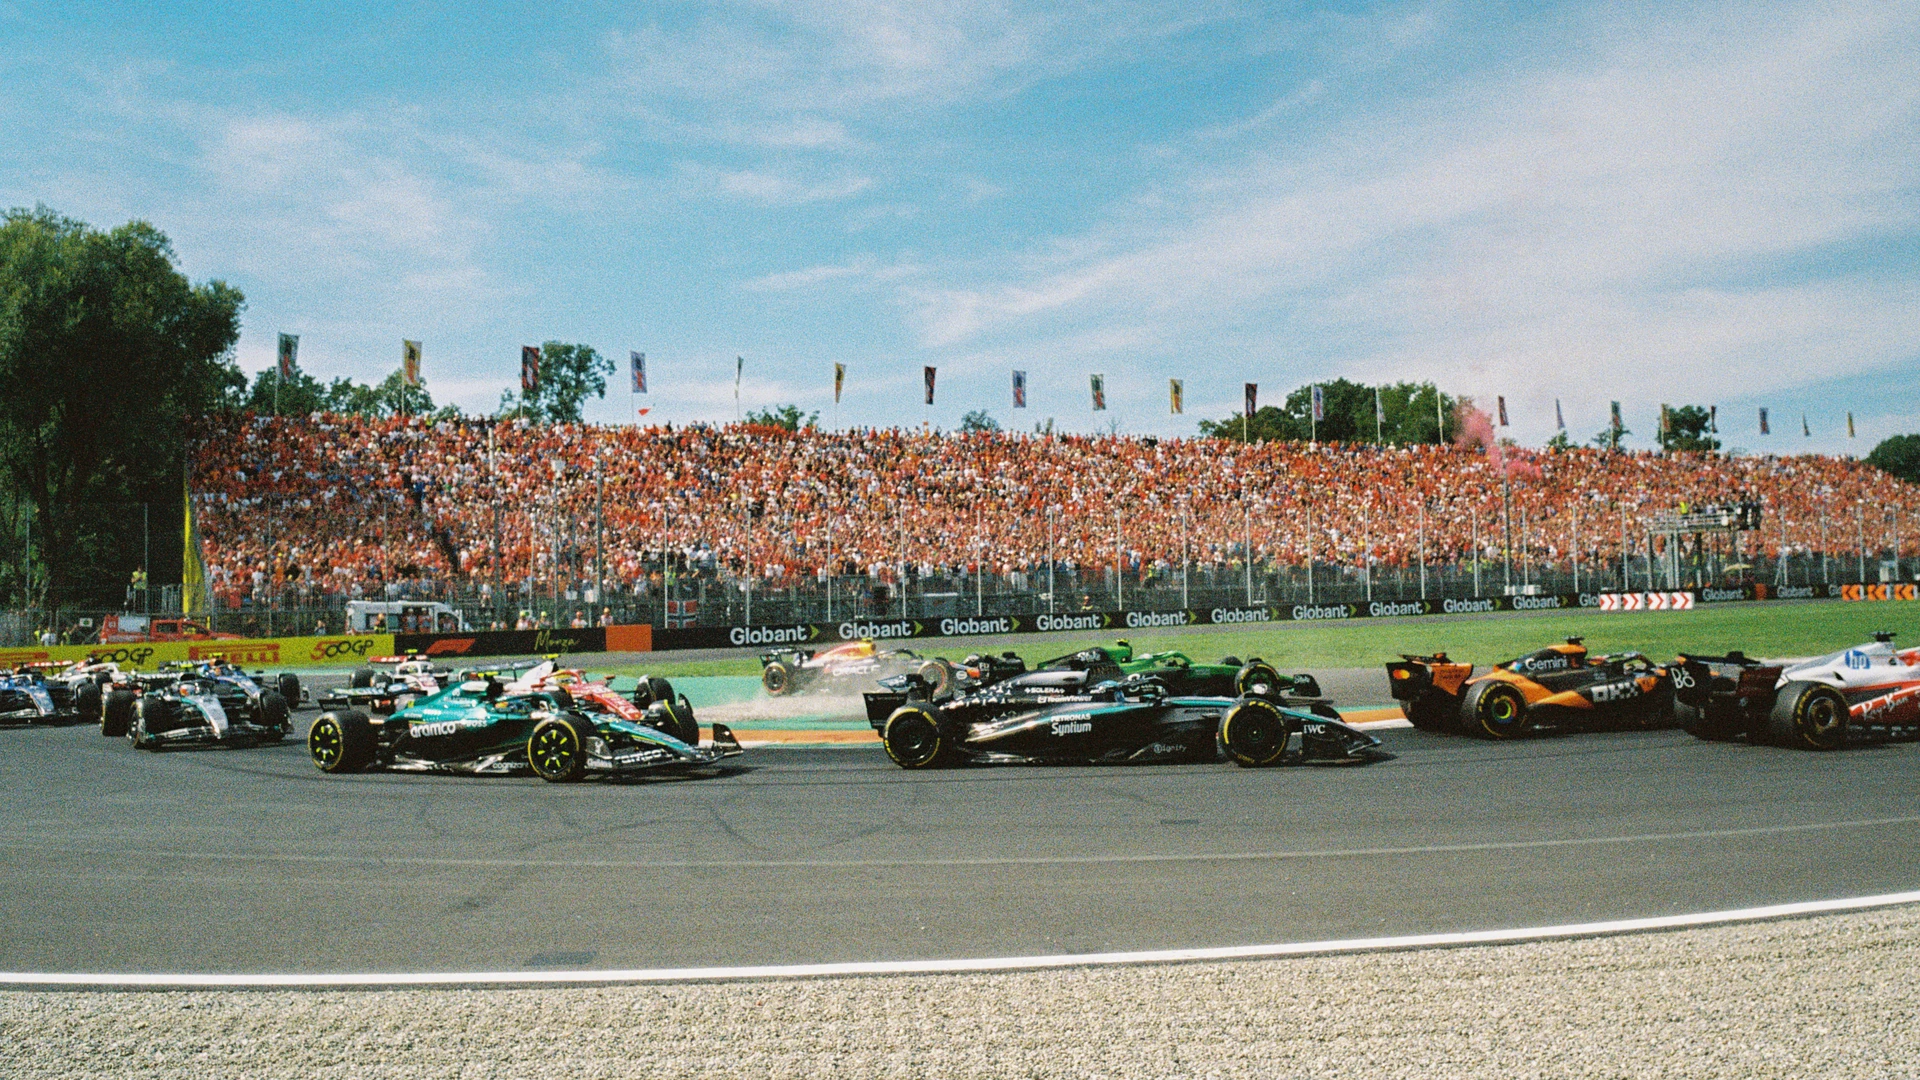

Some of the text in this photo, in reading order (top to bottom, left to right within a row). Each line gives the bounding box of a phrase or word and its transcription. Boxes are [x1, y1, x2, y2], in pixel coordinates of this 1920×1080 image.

[1369, 601, 1424, 617] Globant
[1443, 598, 1494, 613] Globant
[1513, 595, 1560, 610] Globant
[1126, 609, 1187, 628] Globant
[1211, 606, 1270, 624] Globant
[1292, 604, 1348, 620] Globant
[838, 620, 912, 640] Globant
[940, 616, 1009, 635] Globant
[1036, 613, 1101, 632] Globant
[729, 625, 807, 645] Globant
[188, 643, 280, 663] PIELLI
[1525, 655, 1567, 672] Gemini
[410, 721, 457, 739] aramco
[1051, 722, 1092, 737] Syntium
[1303, 723, 1326, 735] IWC
